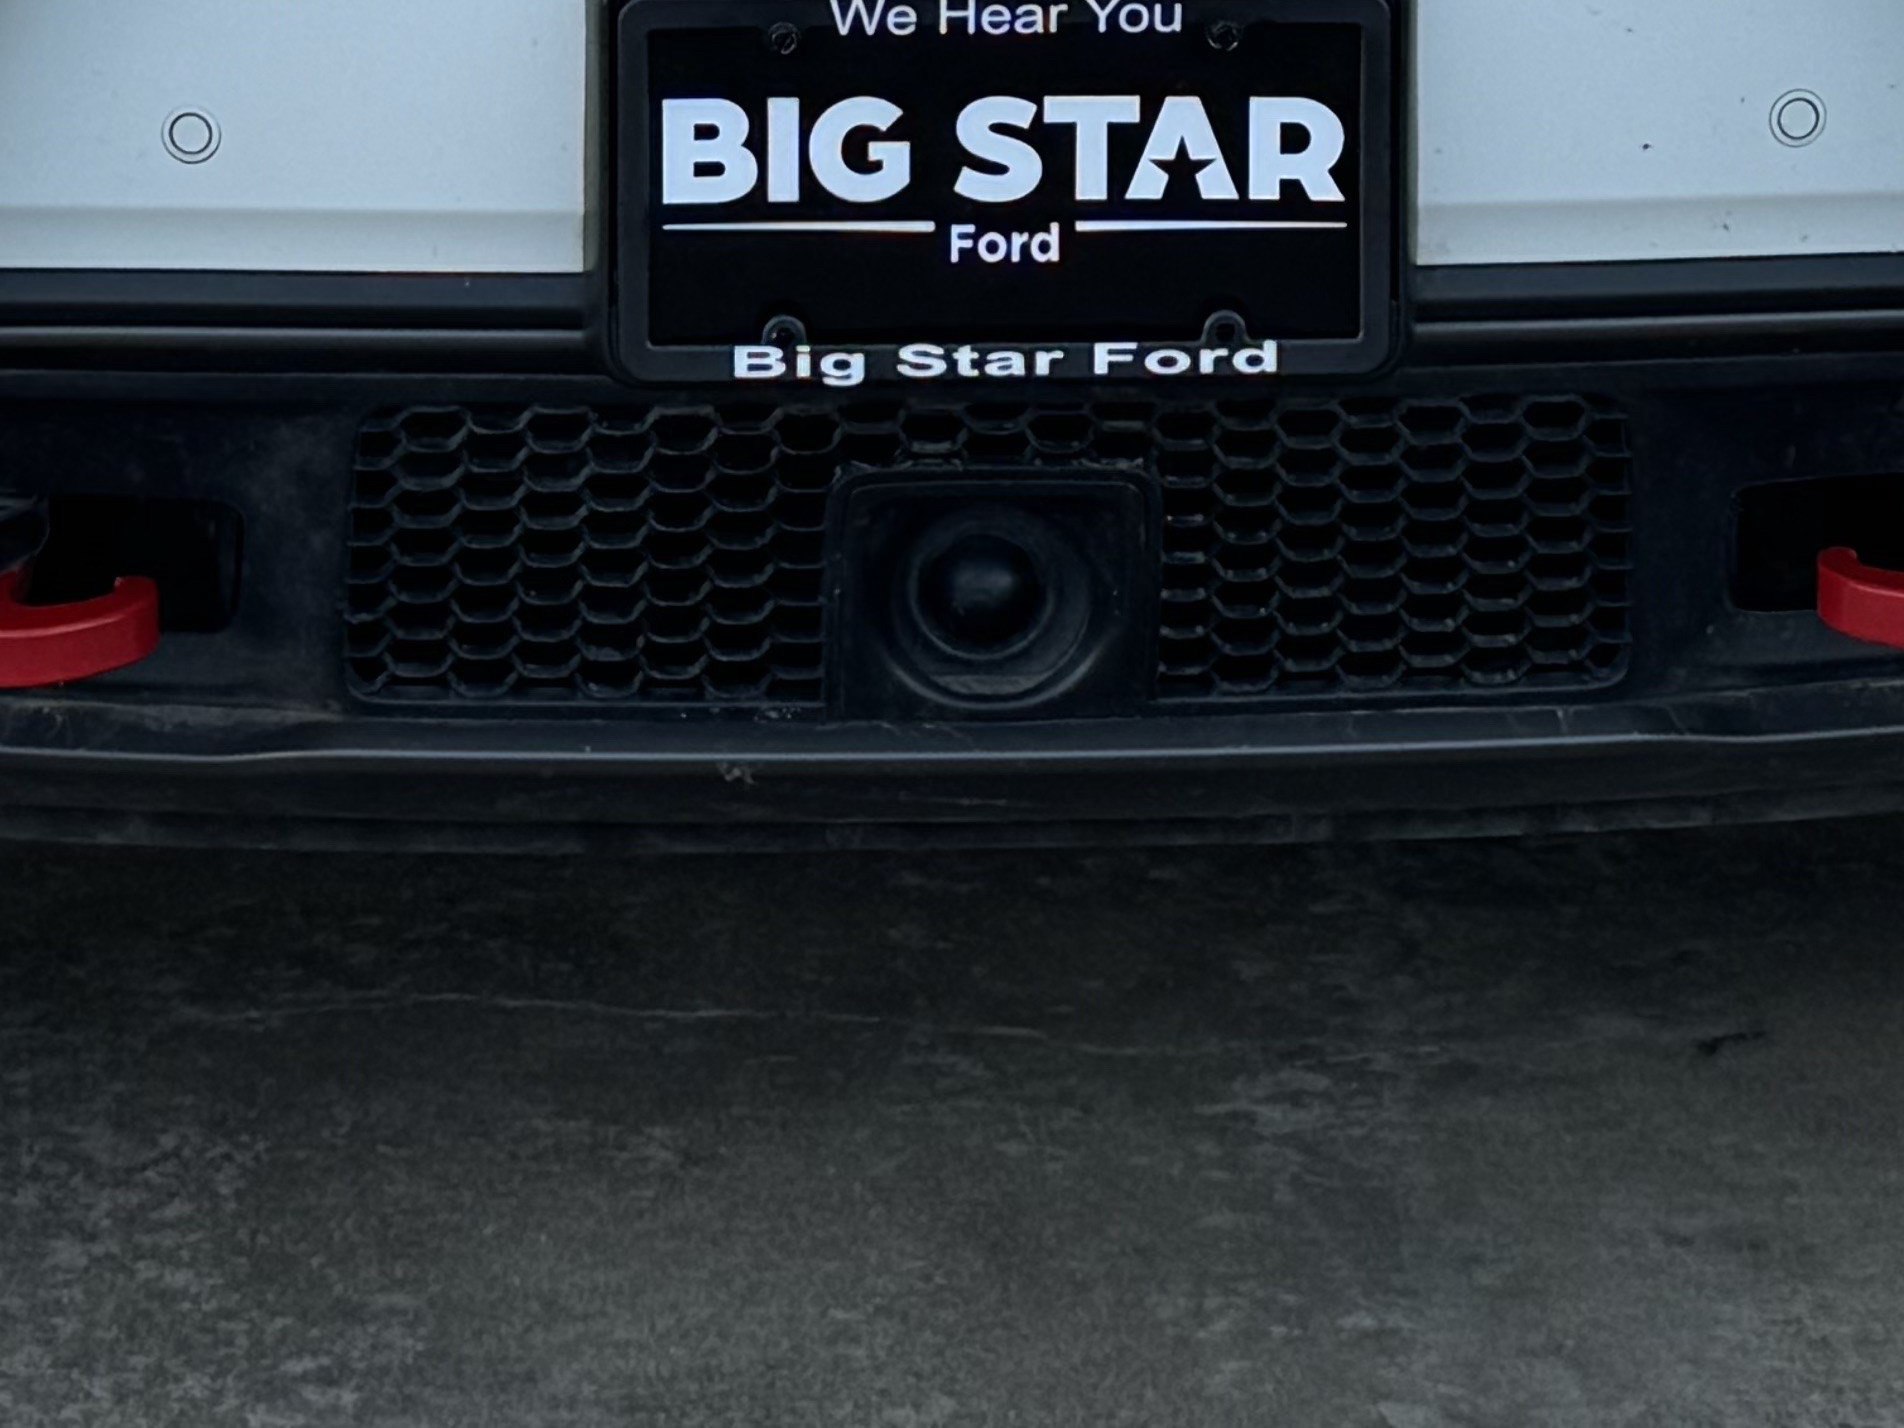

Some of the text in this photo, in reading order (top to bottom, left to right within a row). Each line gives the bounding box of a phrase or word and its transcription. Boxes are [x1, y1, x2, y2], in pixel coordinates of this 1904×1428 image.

[661, 94, 1346, 205] BIG STAR
[950, 221, 1060, 264] Ford
[733, 338, 1278, 387] Big Star Ford
